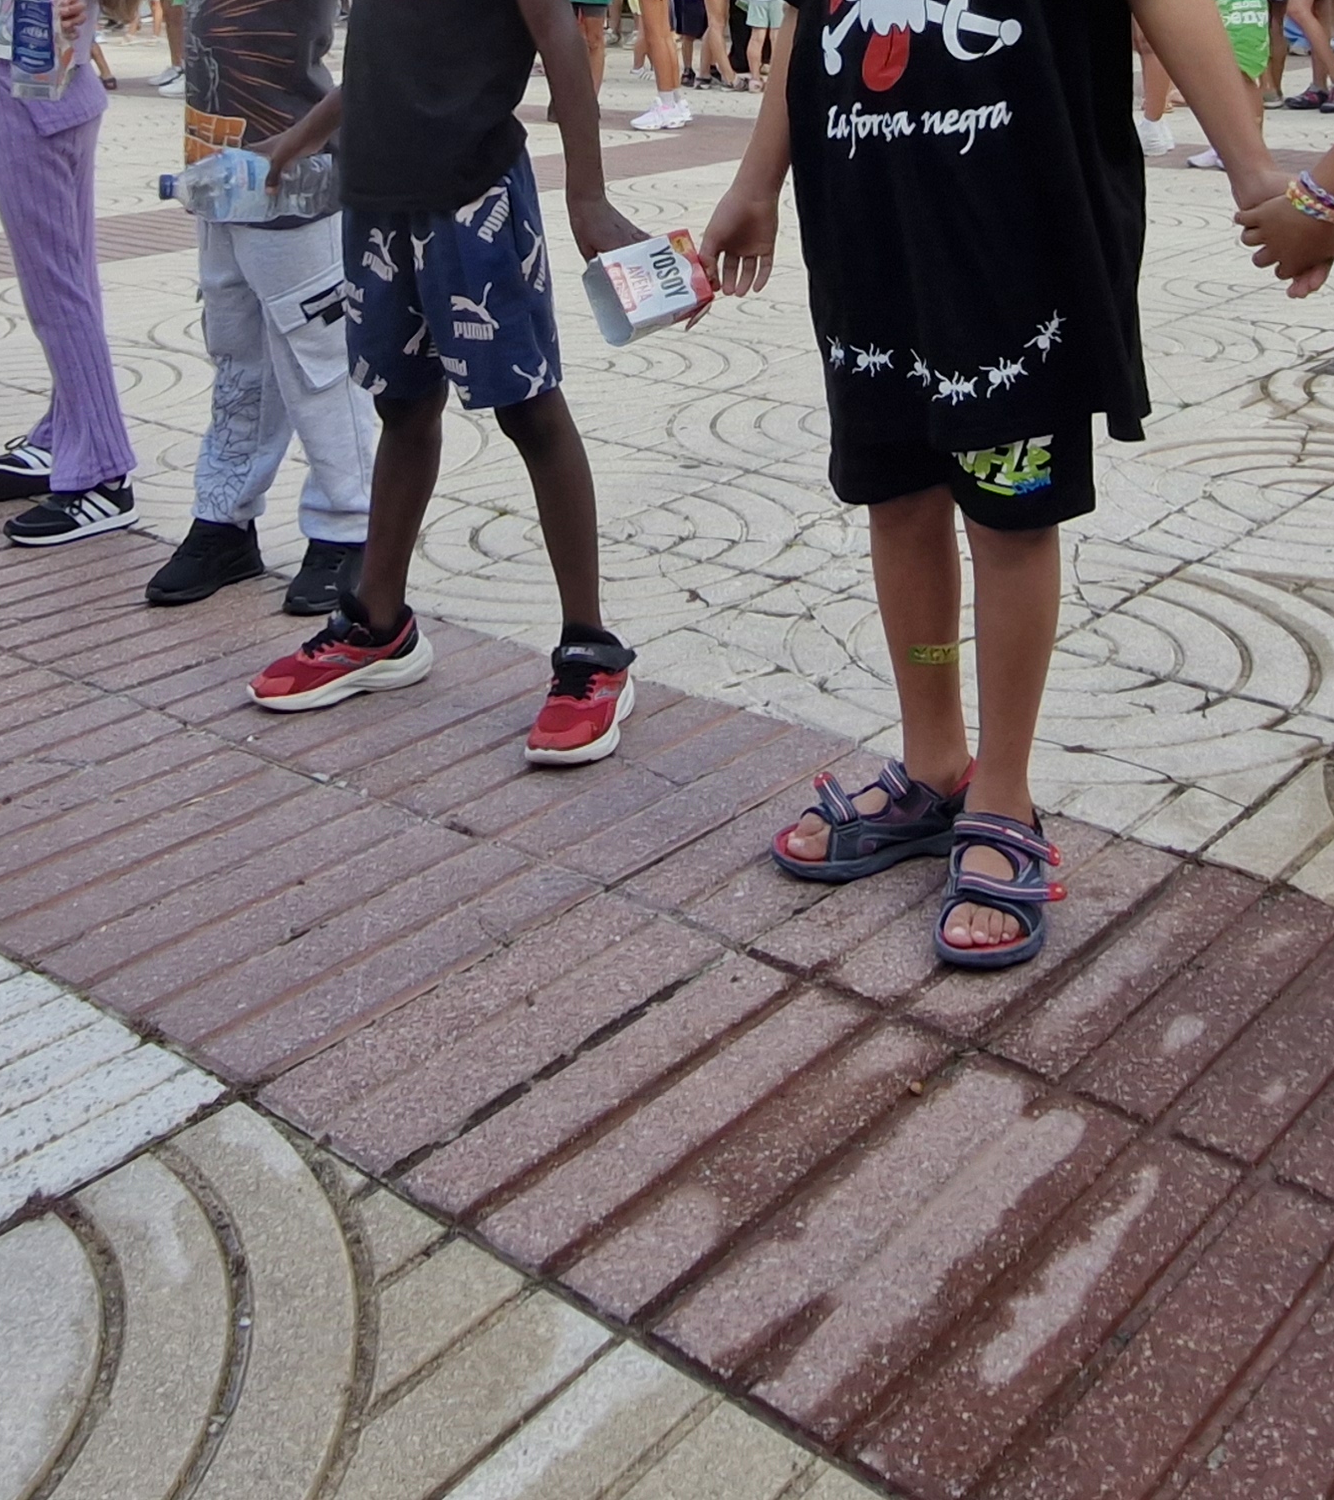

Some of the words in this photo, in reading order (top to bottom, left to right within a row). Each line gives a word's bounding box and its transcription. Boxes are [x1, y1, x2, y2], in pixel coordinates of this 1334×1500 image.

[921, 101, 1013, 155] negra
[650, 245, 690, 298] YOSOY
[453, 321, 494, 340] PUMA
